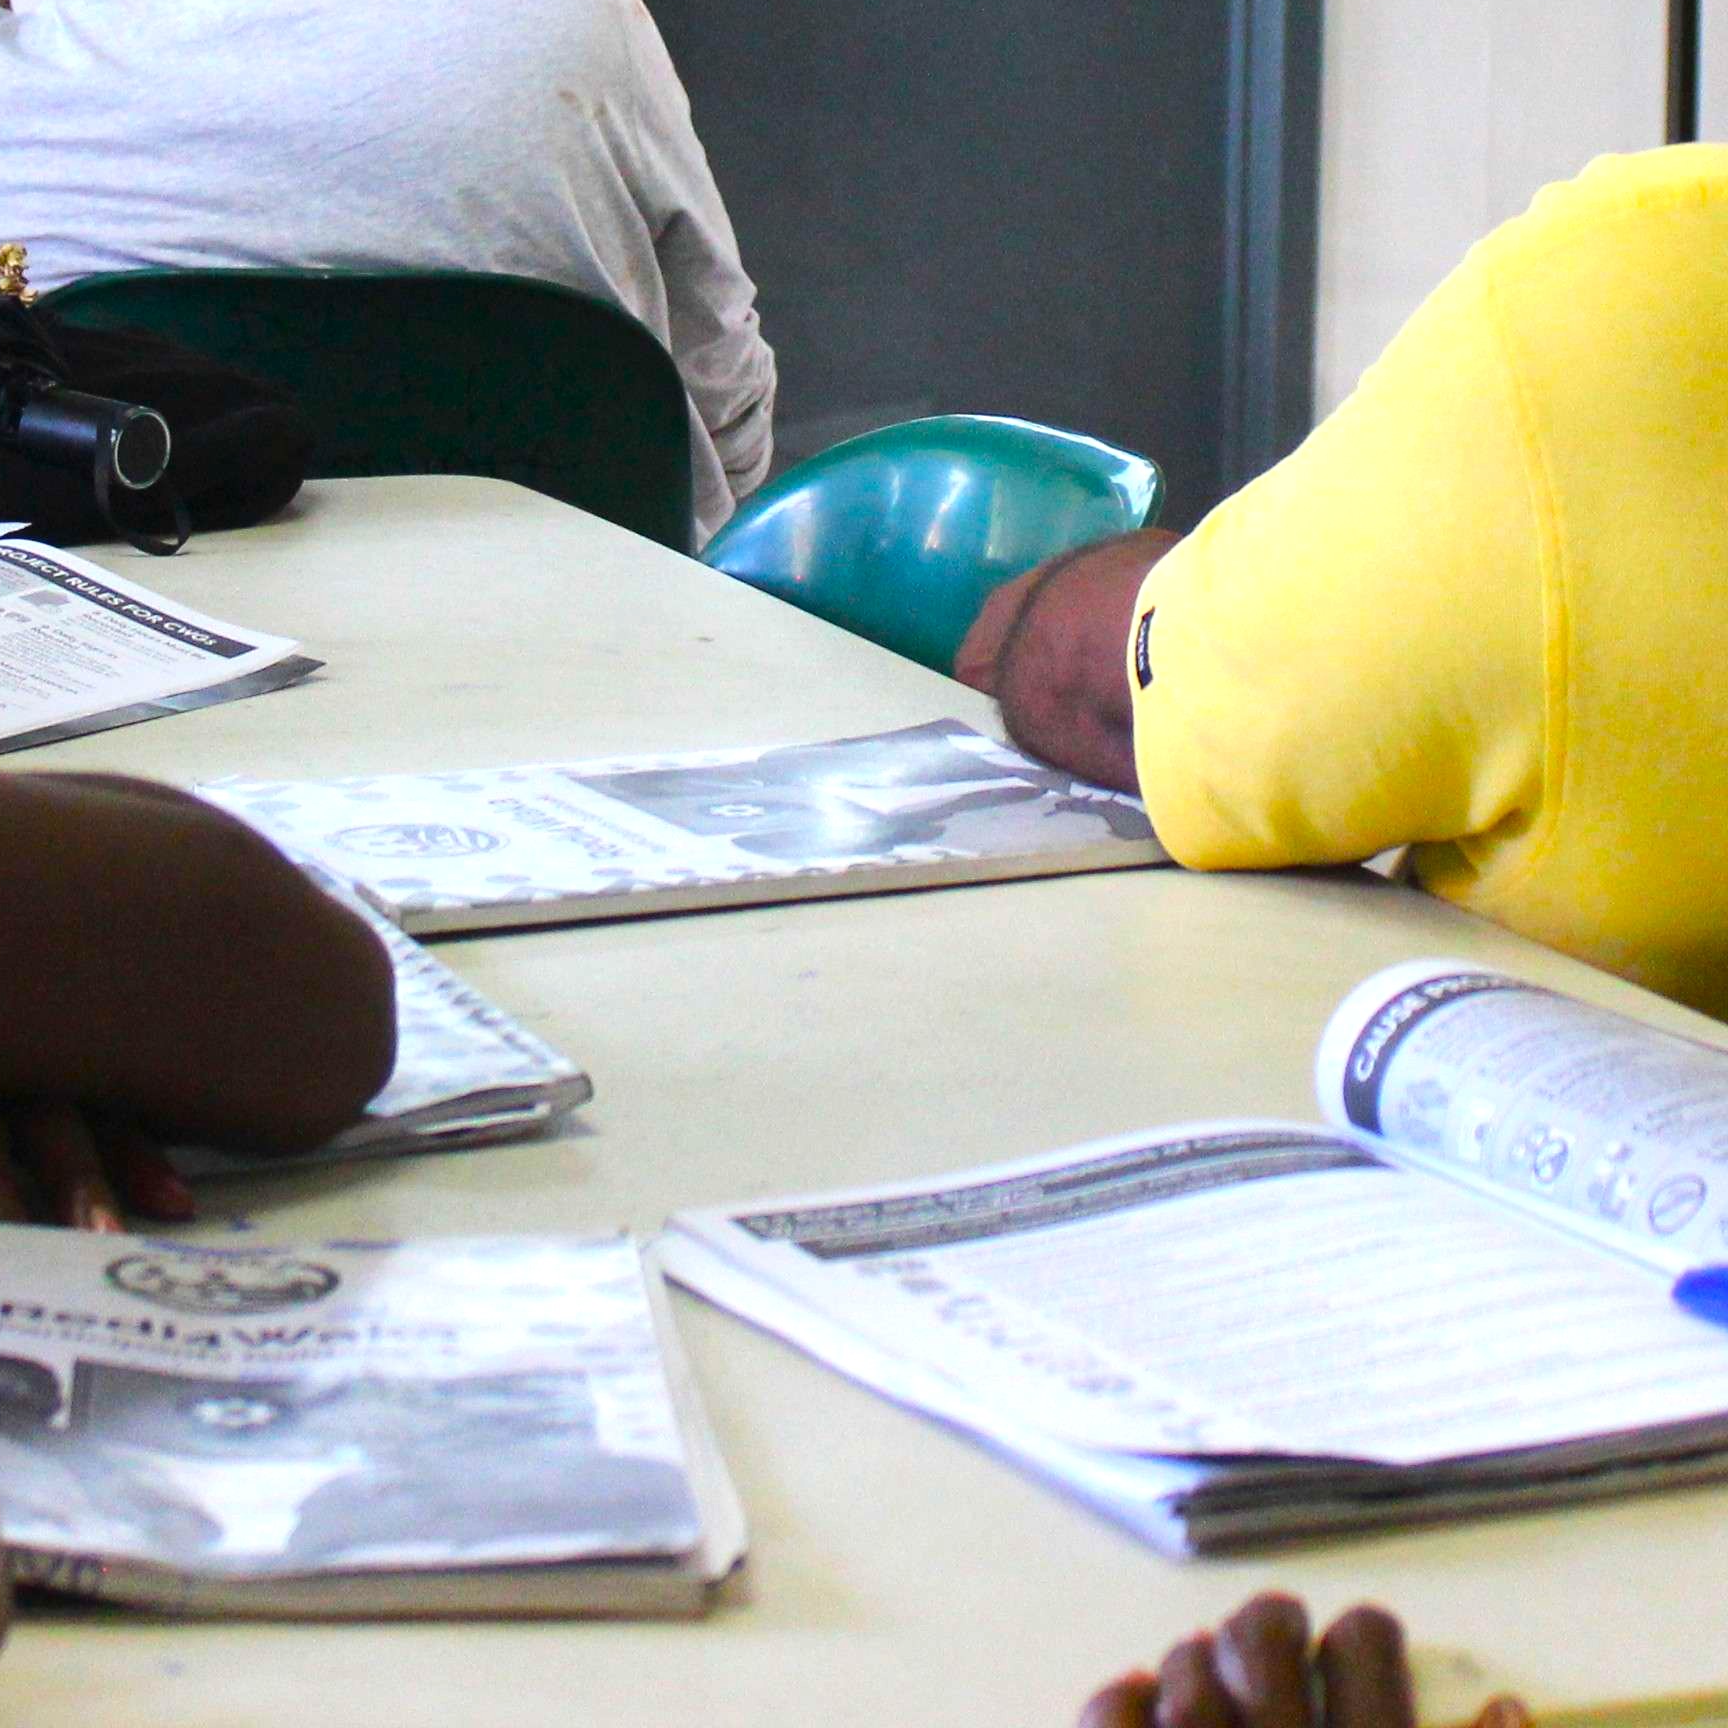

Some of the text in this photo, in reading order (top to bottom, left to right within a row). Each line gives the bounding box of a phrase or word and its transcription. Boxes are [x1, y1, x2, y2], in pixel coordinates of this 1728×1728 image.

[65, 575, 125, 607] RULES
[121, 603, 164, 626] FOR
[162, 619, 218, 648] CWGs
